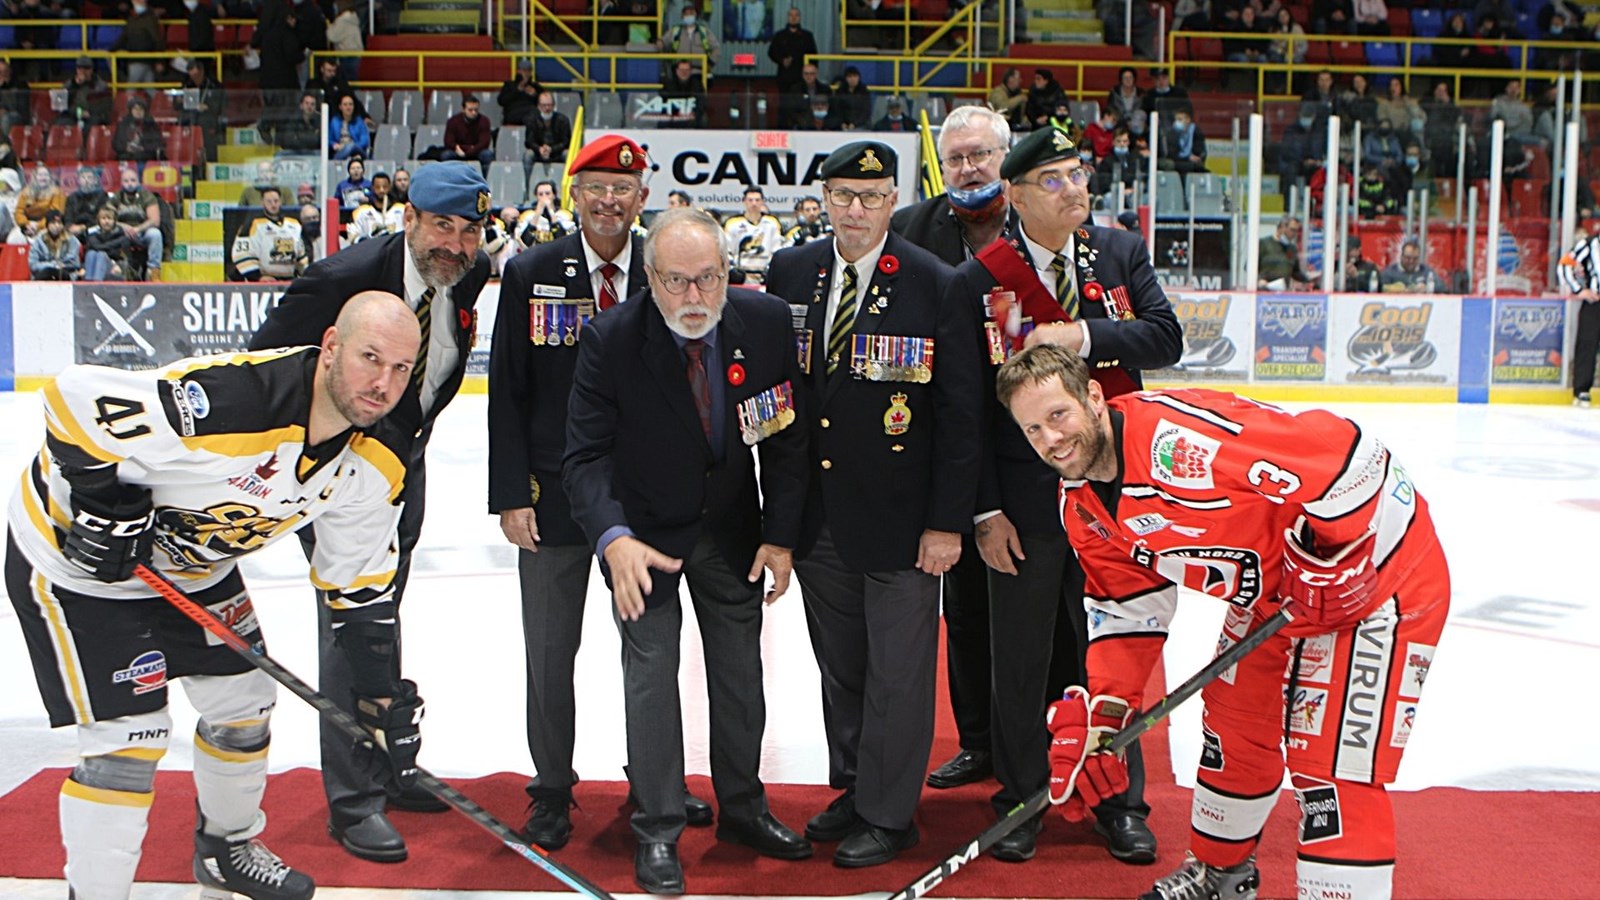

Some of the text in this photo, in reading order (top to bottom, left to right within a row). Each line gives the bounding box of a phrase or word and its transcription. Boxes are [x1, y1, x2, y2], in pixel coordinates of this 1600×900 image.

[672, 151, 830, 186] CANA
[1157, 275, 1222, 290] ANAM
[1166, 295, 1232, 320] ool
[1360, 301, 1433, 326] Cool
[190, 334, 232, 343] CUISINE
[1247, 459, 1302, 505] 3
[1198, 551, 1246, 560] NORD
[1283, 549, 1369, 587] CM
